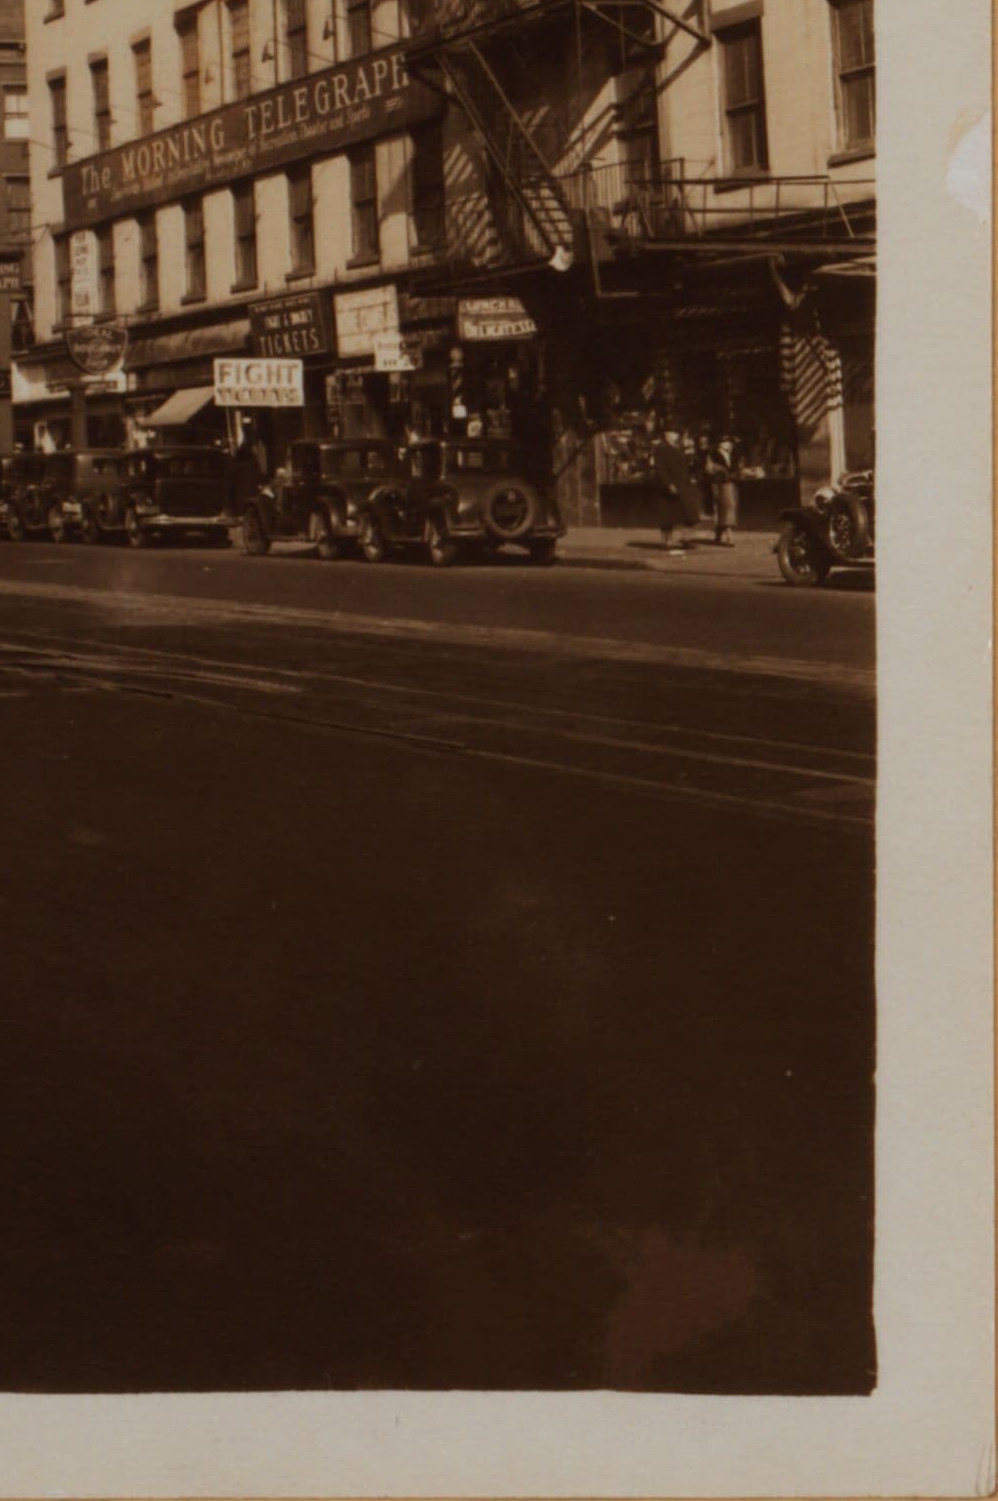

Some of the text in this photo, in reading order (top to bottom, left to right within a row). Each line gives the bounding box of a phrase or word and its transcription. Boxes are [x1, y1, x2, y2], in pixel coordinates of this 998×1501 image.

[81, 165, 112, 197] The
[121, 117, 225, 180] MORNING
[244, 52, 411, 139] TELEGRAPH
[259, 327, 320, 357] TICKETS
[219, 363, 299, 385] FIGHT
